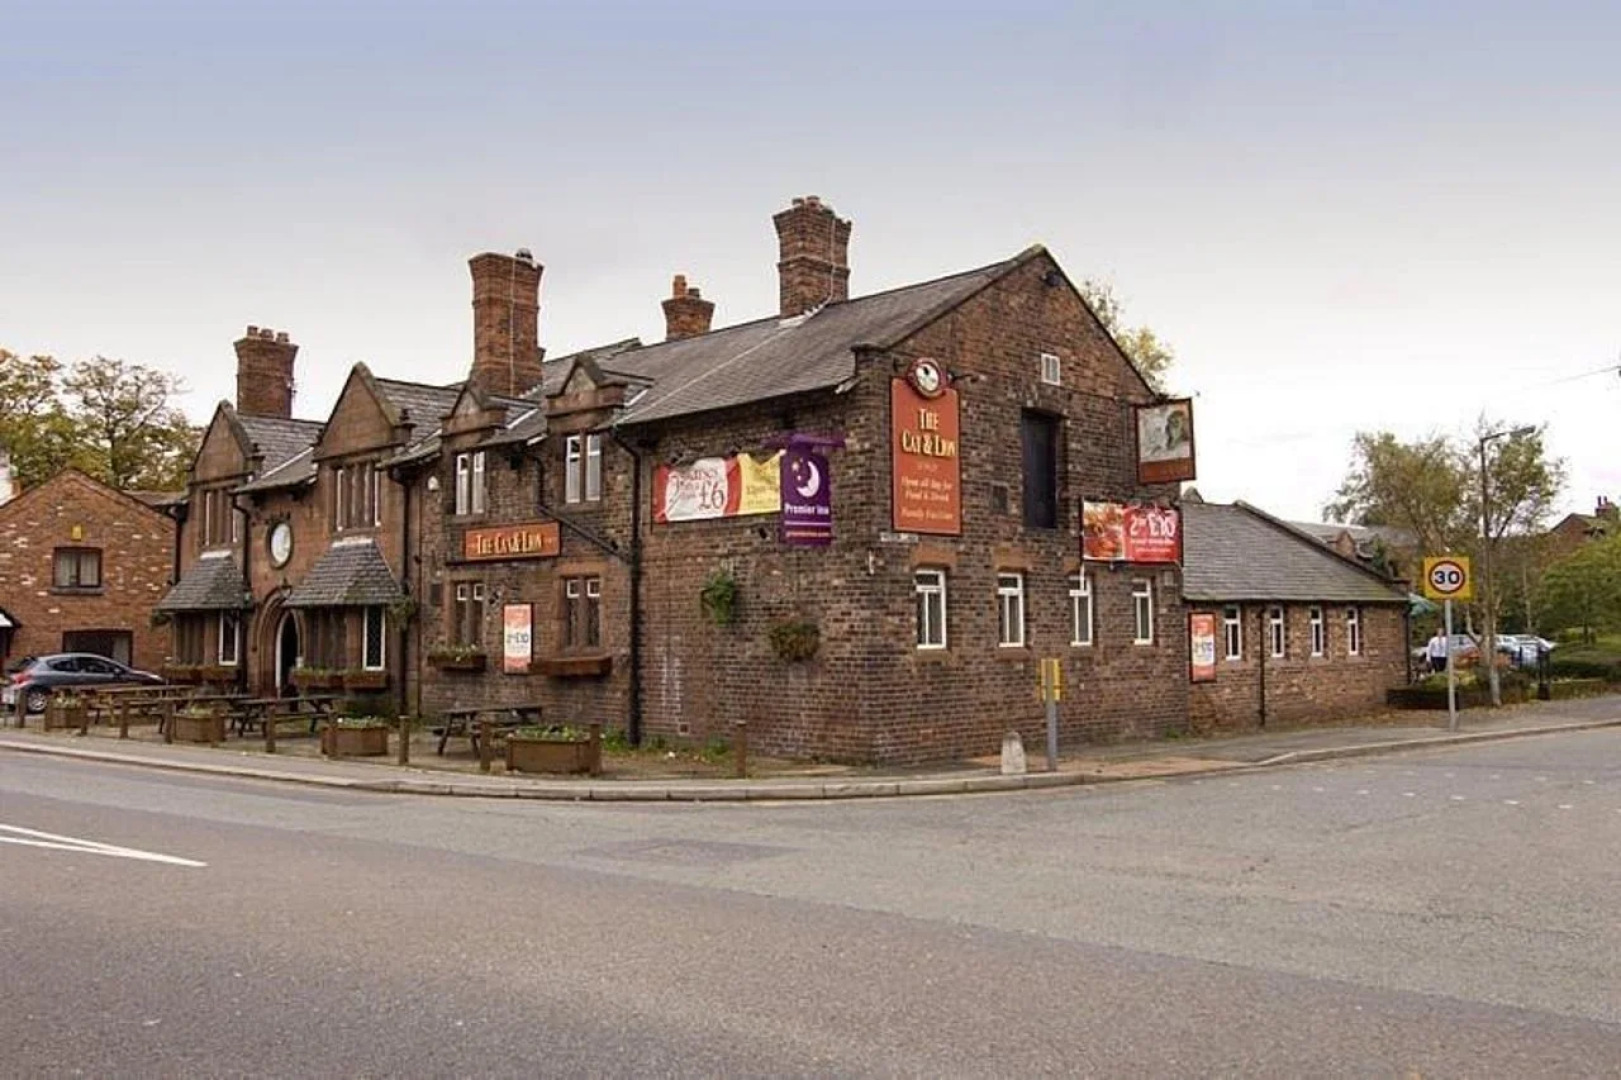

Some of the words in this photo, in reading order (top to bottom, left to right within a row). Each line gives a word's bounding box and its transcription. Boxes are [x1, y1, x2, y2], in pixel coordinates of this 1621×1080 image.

[919, 408, 940, 430] THE
[784, 502, 815, 515] Premier
[1434, 570, 1460, 584] 30
